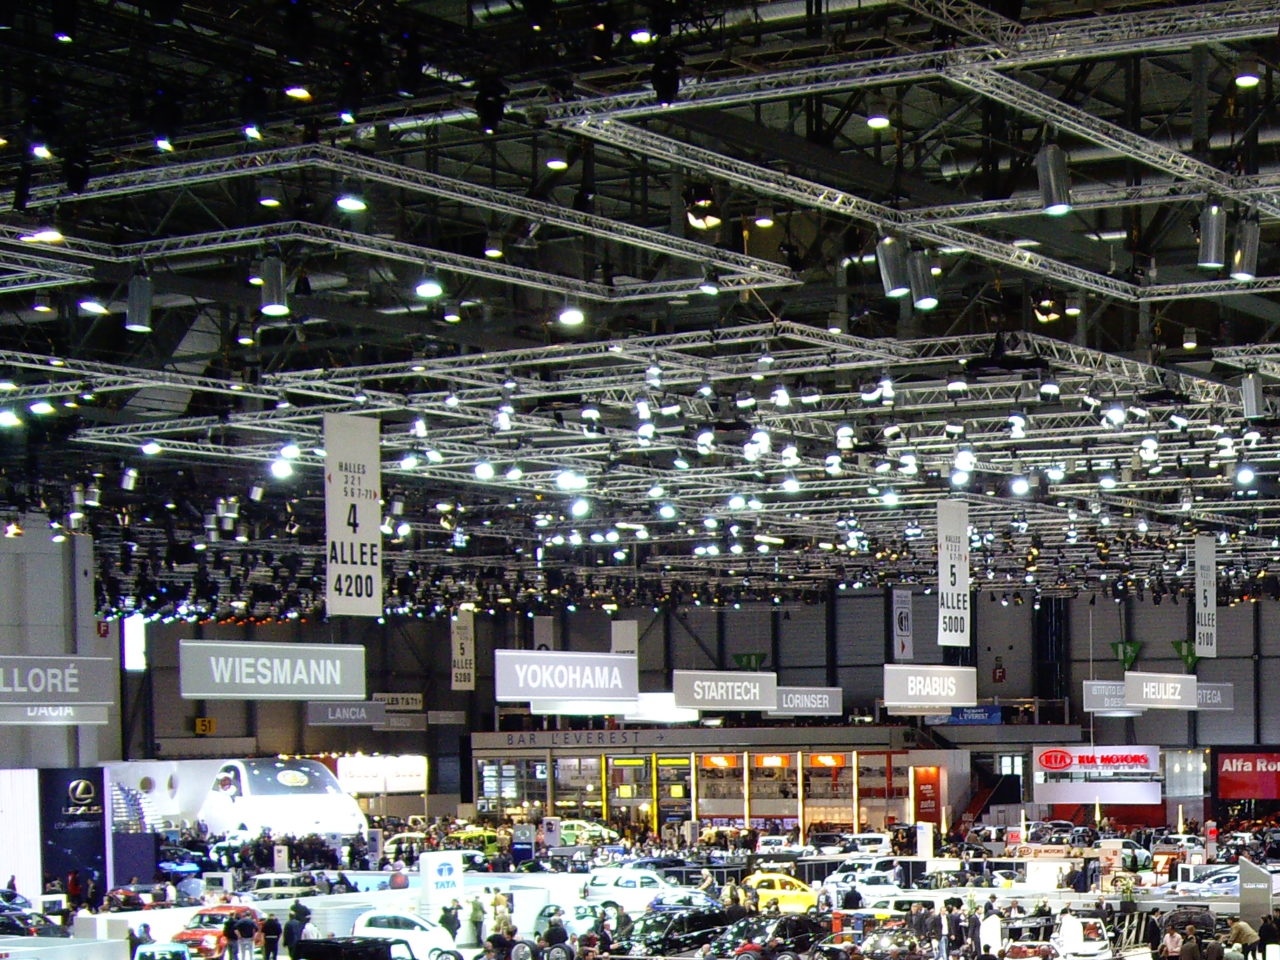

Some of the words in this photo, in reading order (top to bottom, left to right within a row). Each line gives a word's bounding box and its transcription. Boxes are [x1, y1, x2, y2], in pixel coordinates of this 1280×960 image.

[338, 461, 367, 475] HALLES
[347, 503, 359, 534] 4
[329, 541, 379, 567] ALLEE
[950, 564, 956, 587] 5
[333, 573, 374, 598] 4200
[940, 592, 968, 611] ALLEE
[1203, 589, 1208, 608] 5
[942, 616, 965, 633] 5000
[1196, 612, 1215, 627] ALLEE
[1198, 632, 1214, 646] 5100
[459, 642, 465, 656] 5
[210, 656, 341, 685] WIESMANN
[452, 658, 473, 669] ALLEE
[515, 664, 623, 689] YOKOHAMA
[694, 681, 760, 700] STARTECH
[907, 676, 957, 697] BRABUS
[1143, 682, 1182, 700] HEULIEZ
[782, 694, 830, 709] LORINSER
[328, 707, 367, 720] LANCIA
[507, 734, 537, 745] BAR
[551, 731, 641, 745] L'EVEREST
[1078, 755, 1097, 765] KIA
[1100, 754, 1149, 765] MOTORS
[1222, 759, 1253, 773] Alfa
[62, 806, 103, 815] LEXUS
[434, 880, 457, 889] TATA
